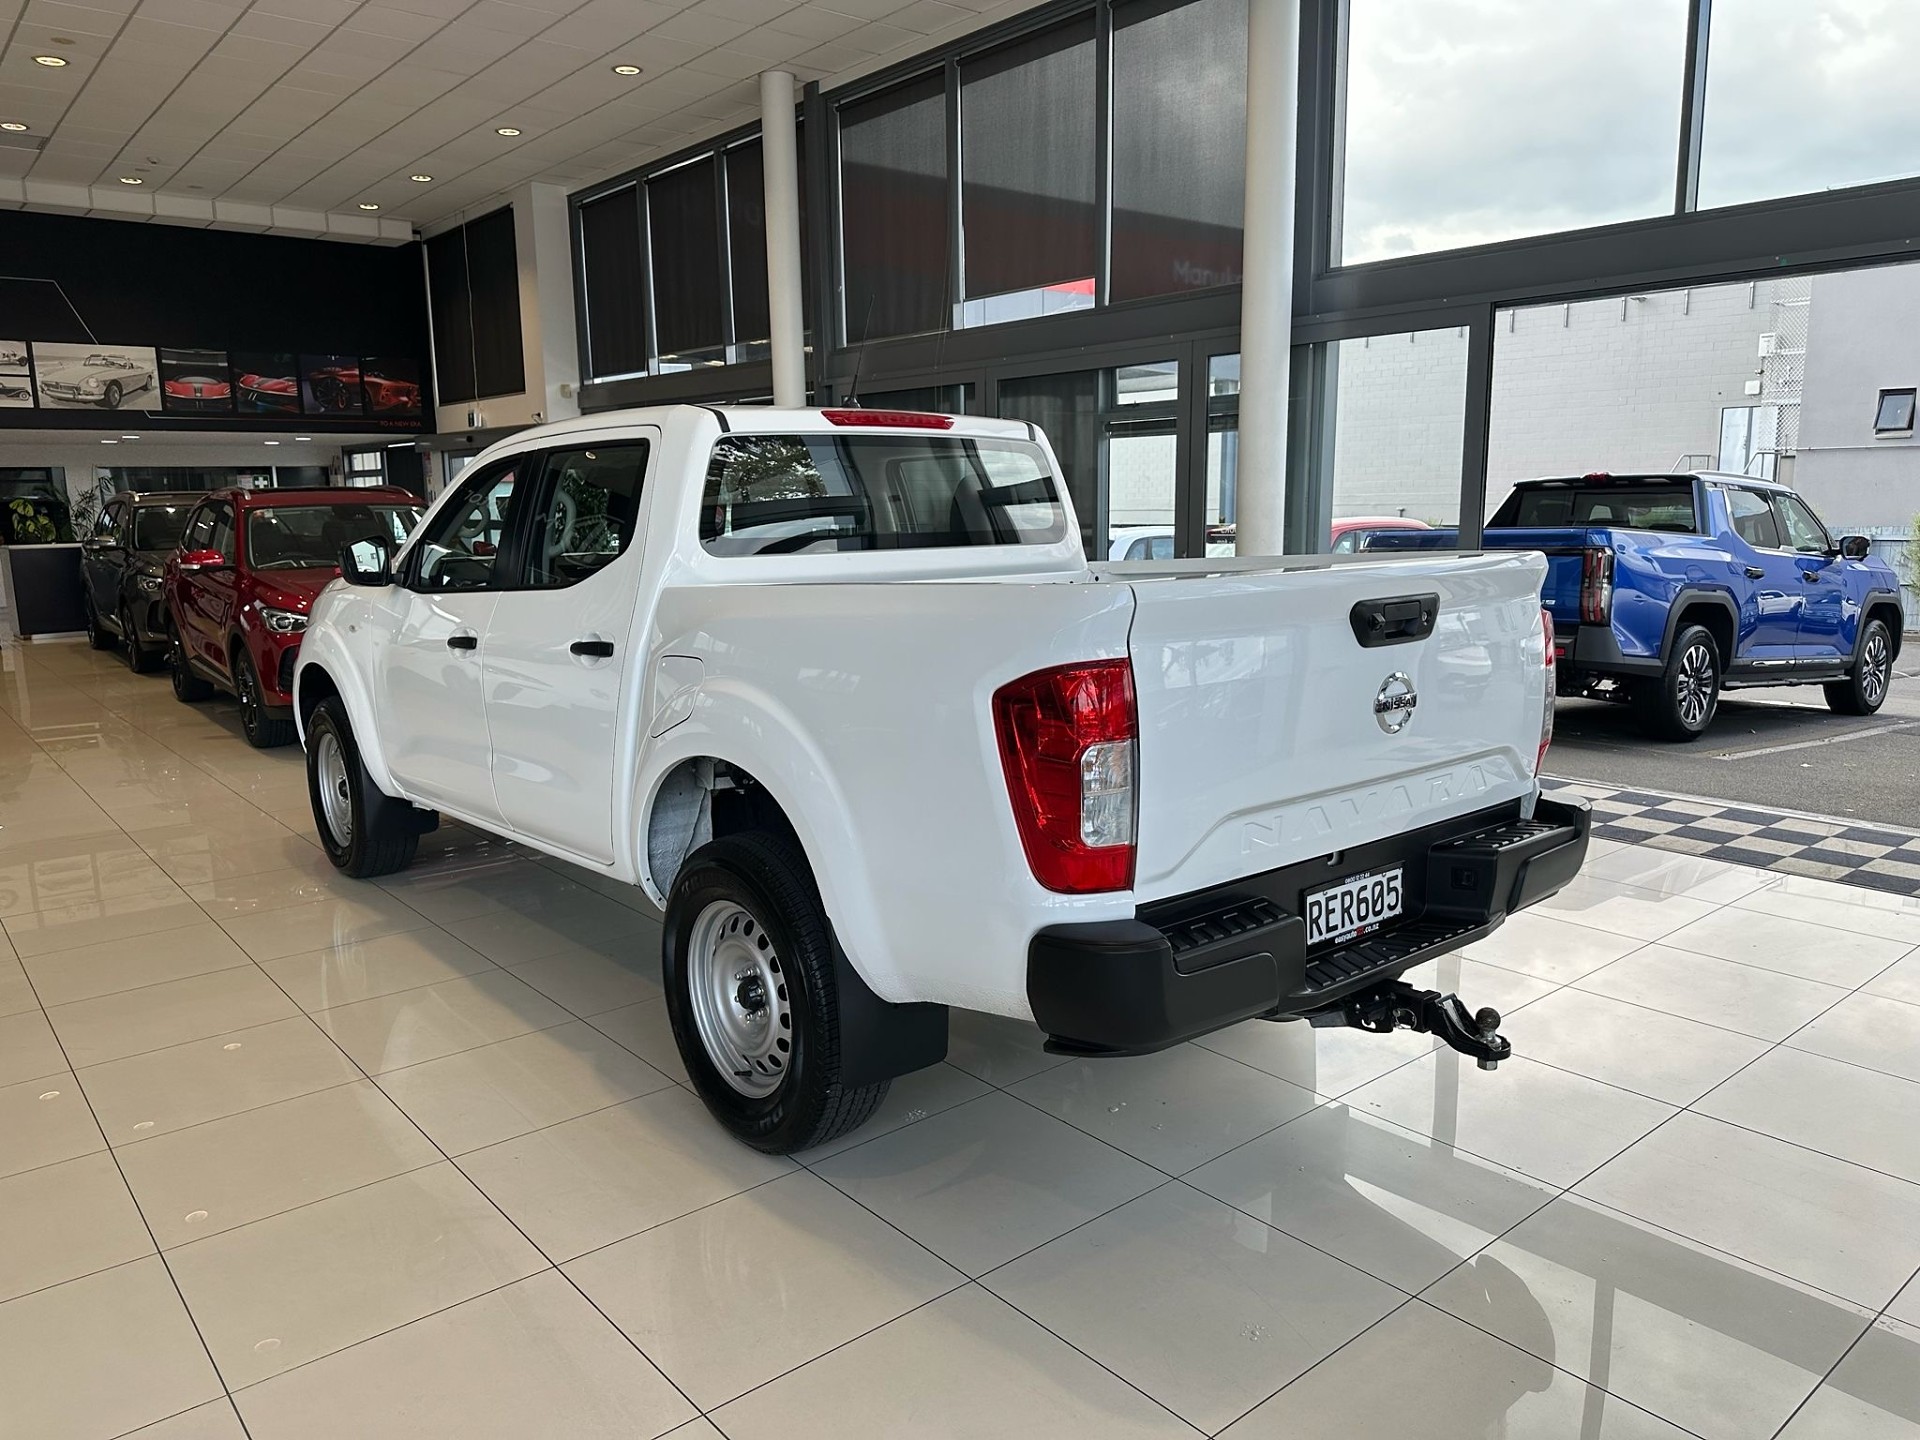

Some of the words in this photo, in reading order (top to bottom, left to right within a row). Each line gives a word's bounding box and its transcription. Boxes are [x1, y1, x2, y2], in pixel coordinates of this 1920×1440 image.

[1382, 694, 1416, 711] NISSAN
[1242, 764, 1488, 854] NAVARA
[1309, 874, 1400, 940] RER605
